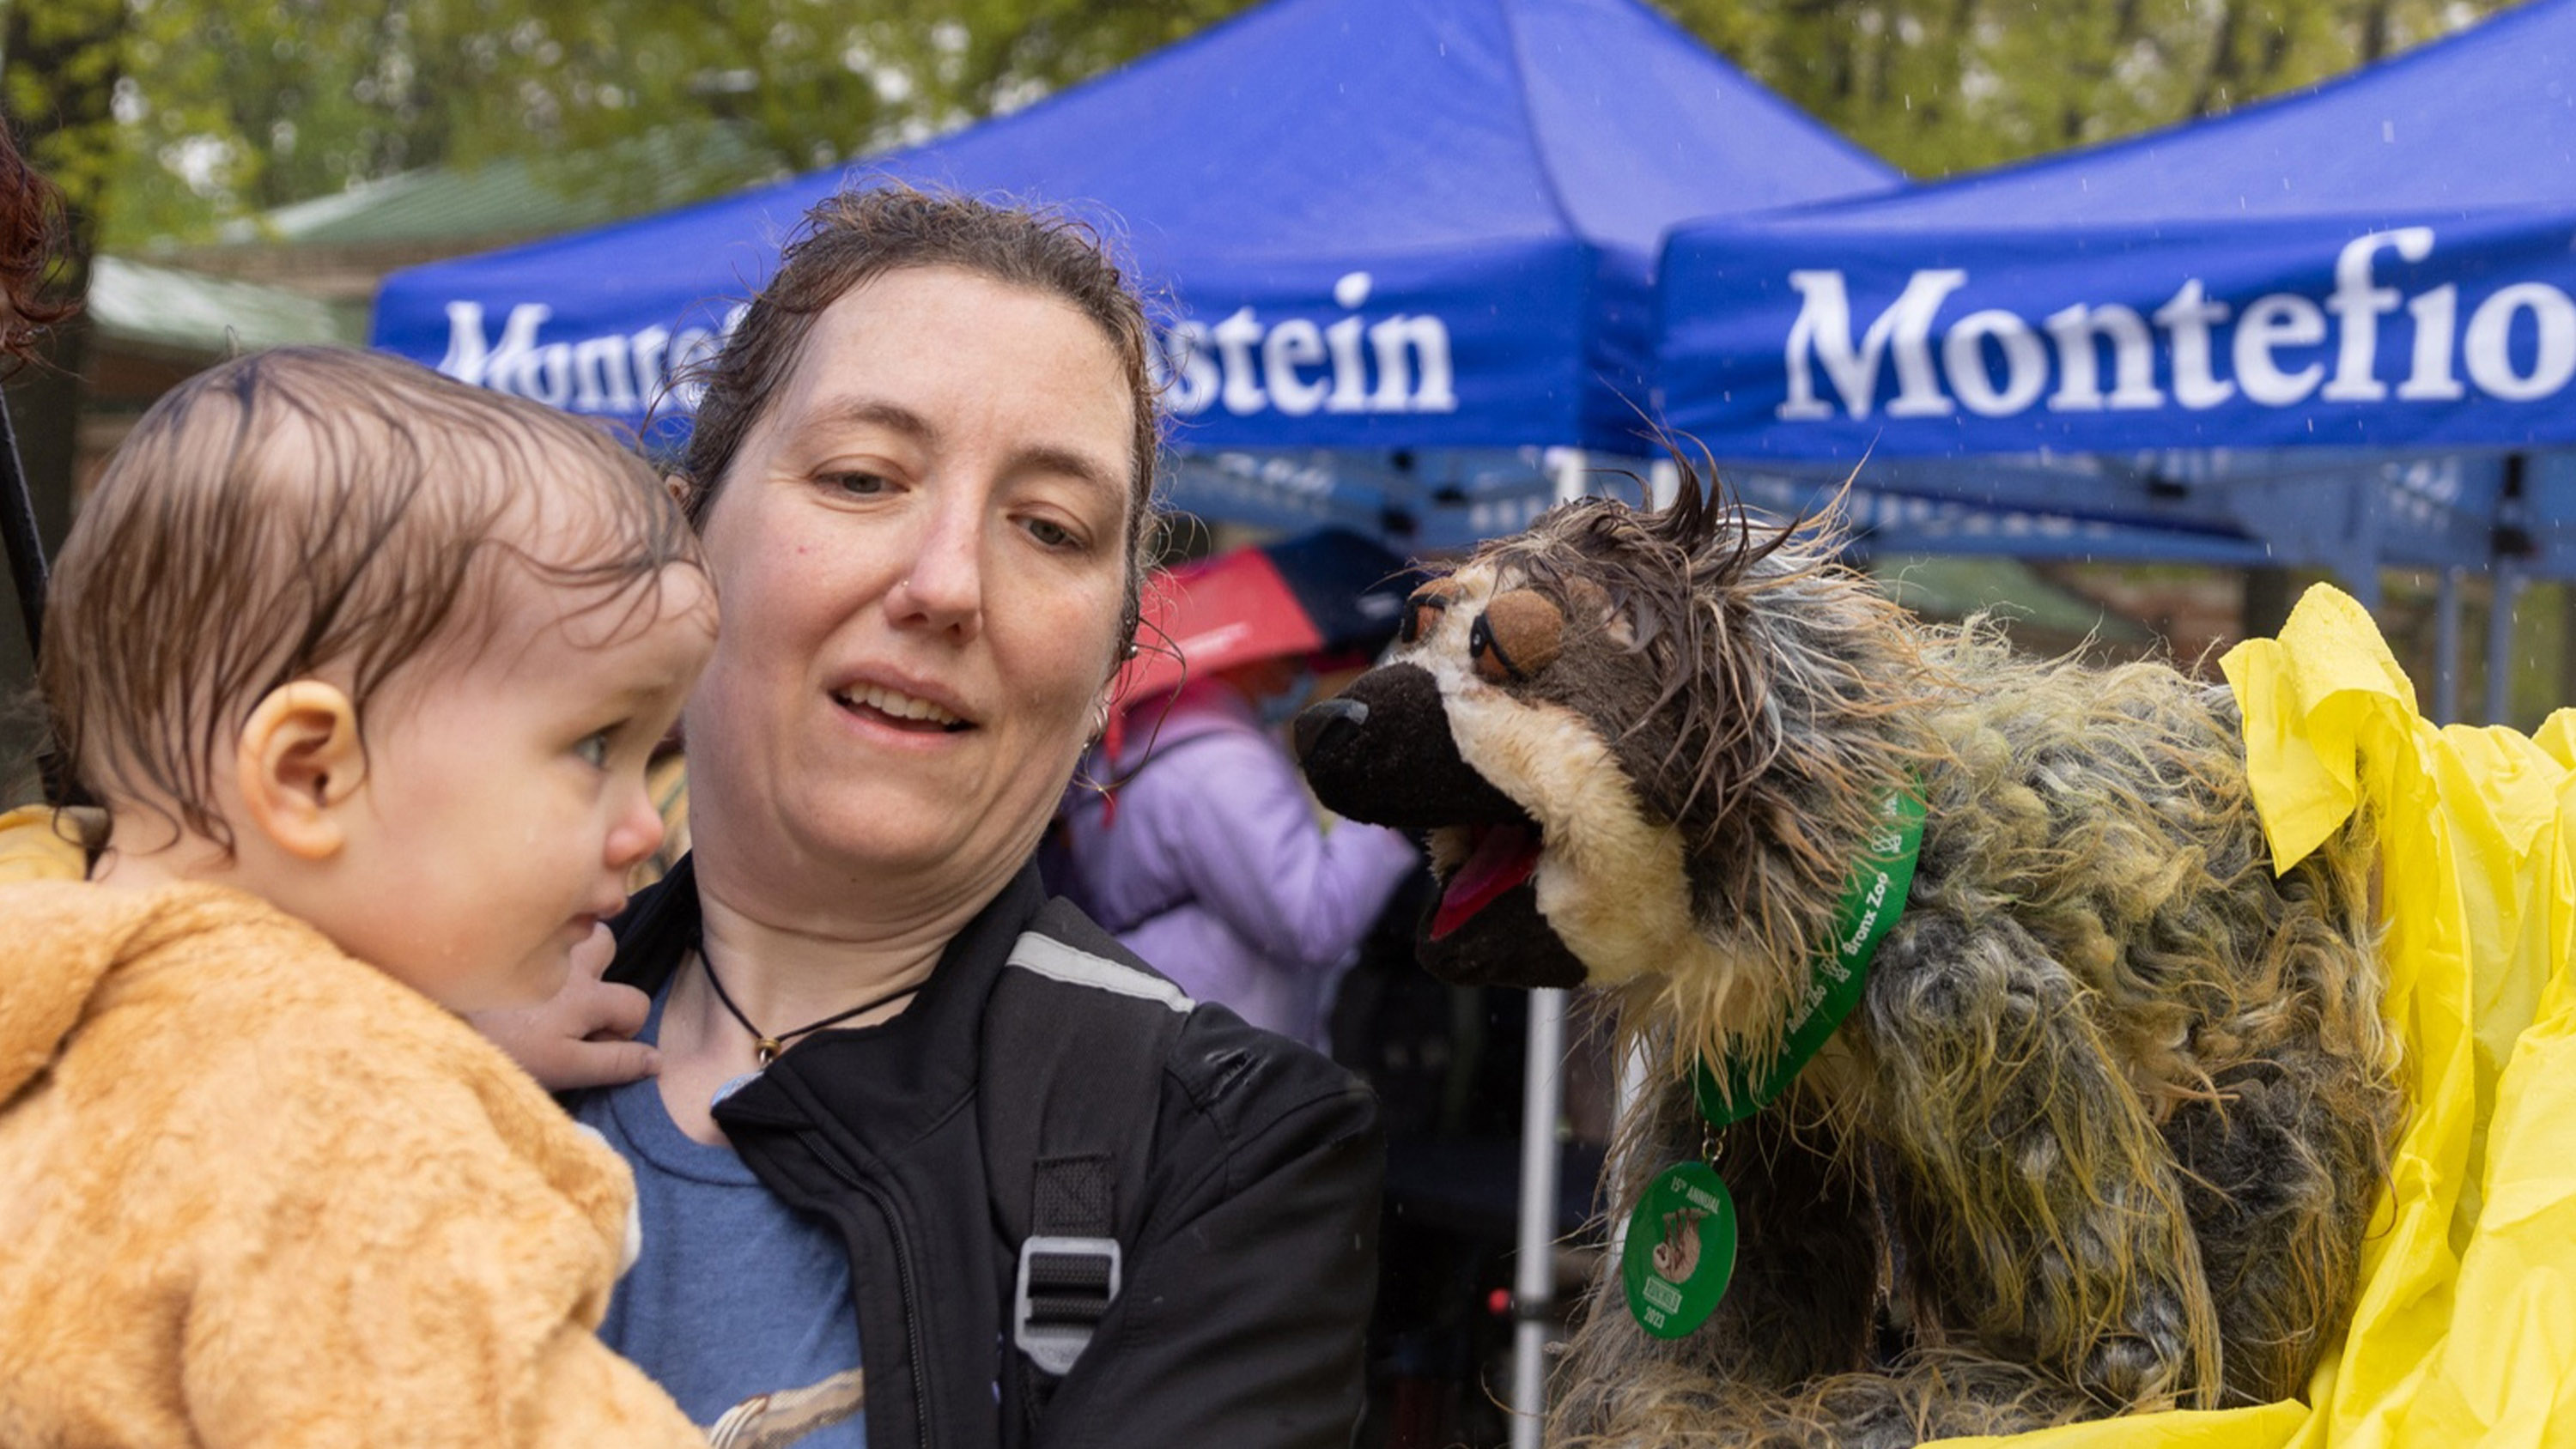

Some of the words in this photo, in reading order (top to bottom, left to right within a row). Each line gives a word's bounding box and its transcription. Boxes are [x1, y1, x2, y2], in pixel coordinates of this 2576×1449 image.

[437, 300, 749, 413] Monte
[1146, 270, 1459, 417] stein
[1776, 225, 2576, 421] Montefio
[1841, 909, 1878, 956] Bronx
[1866, 871, 1889, 906] Zoo
[1806, 985, 1827, 1009] Zoo
[1686, 1185, 1720, 1215] ANNUAL
